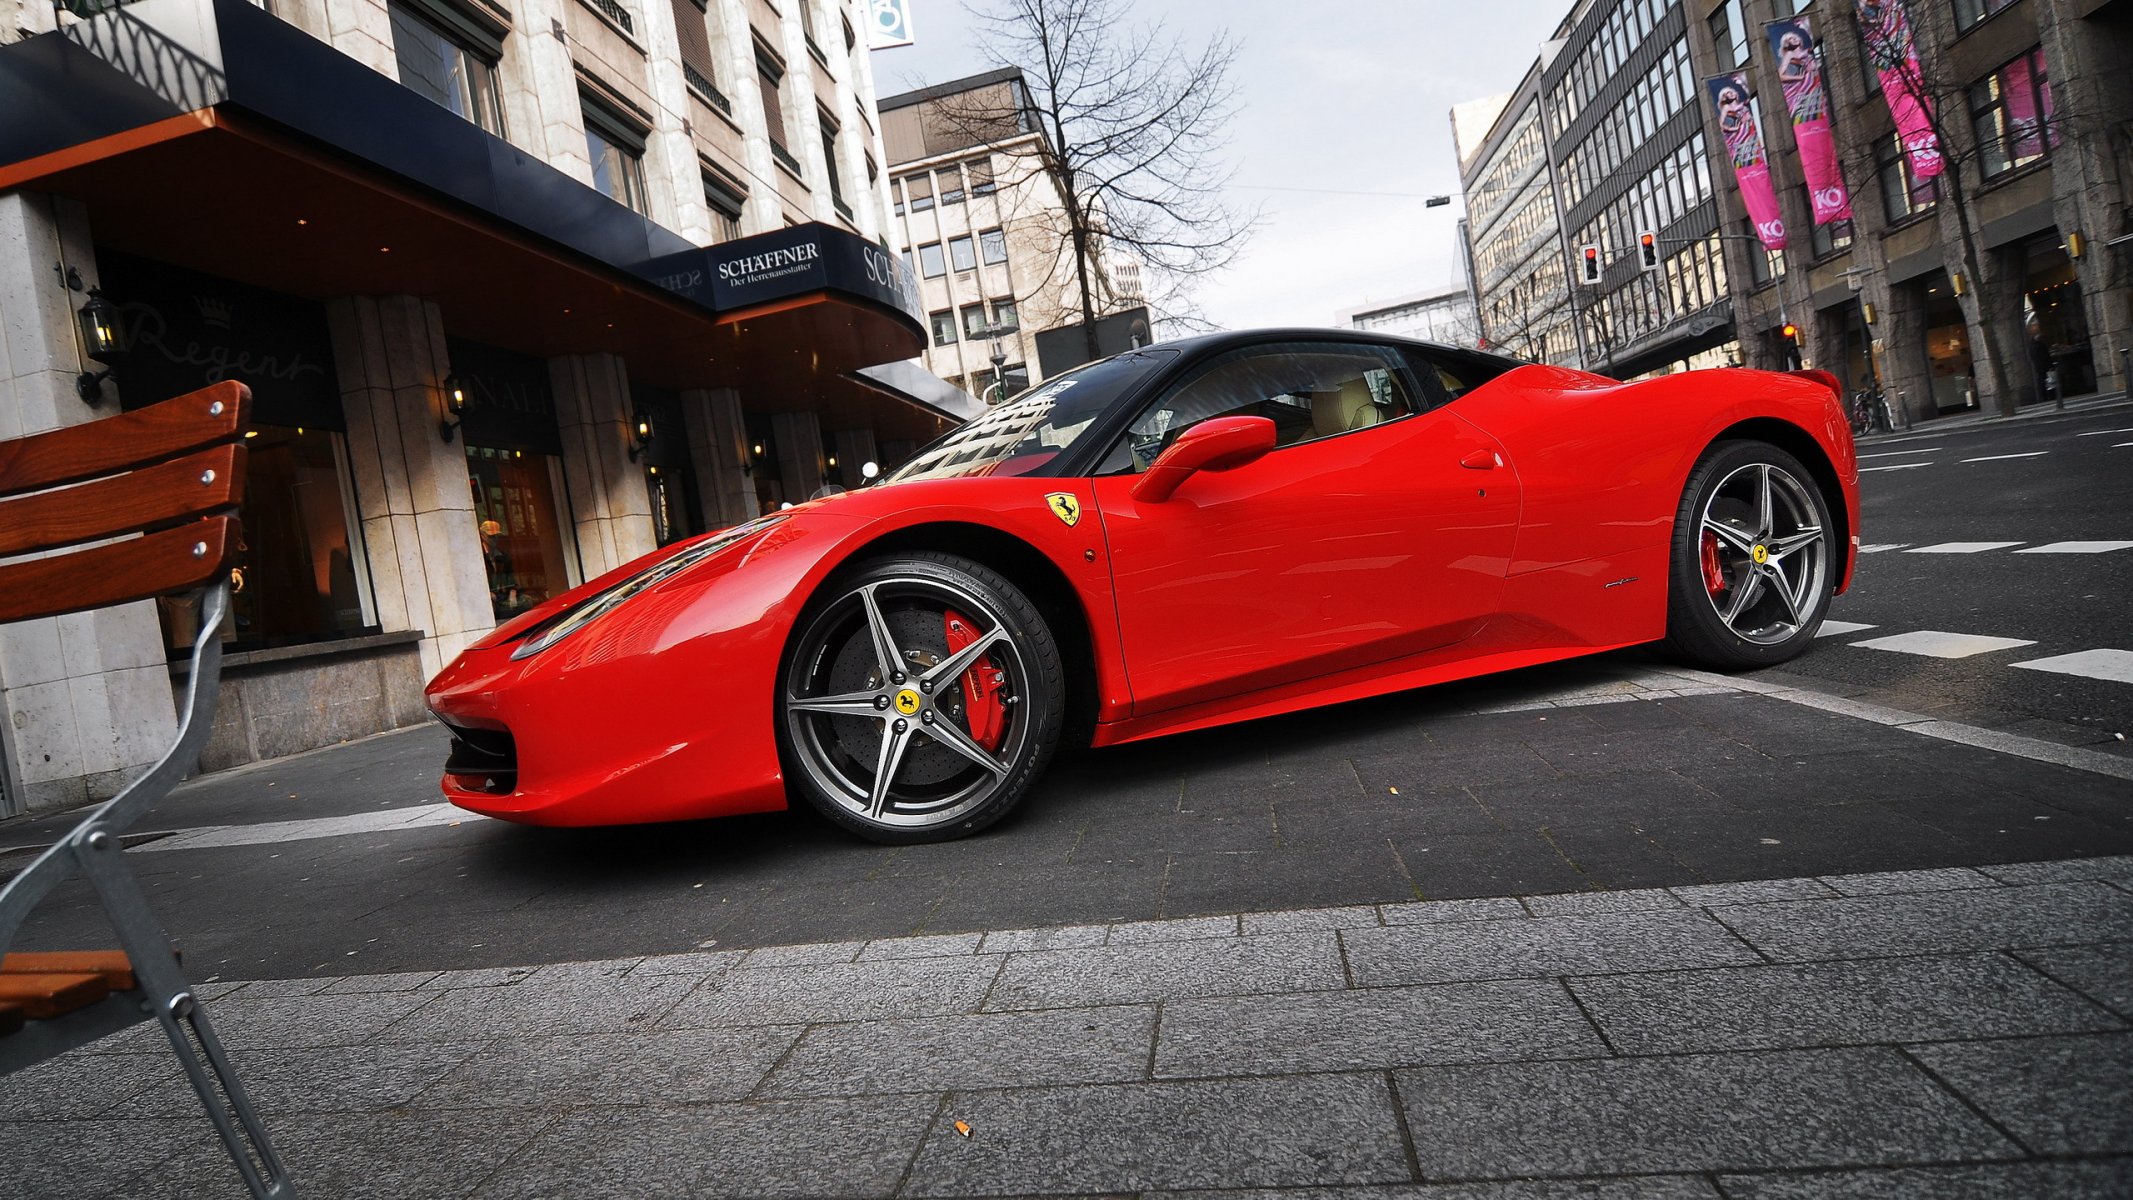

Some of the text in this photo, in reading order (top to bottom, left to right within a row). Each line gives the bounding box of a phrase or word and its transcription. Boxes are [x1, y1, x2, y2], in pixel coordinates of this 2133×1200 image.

[718, 242, 819, 280] SCHÄFFNER
[730, 262, 812, 288] Der Herrenausstatter
[119, 301, 325, 385] Regent
[470, 373, 547, 417] NALI
